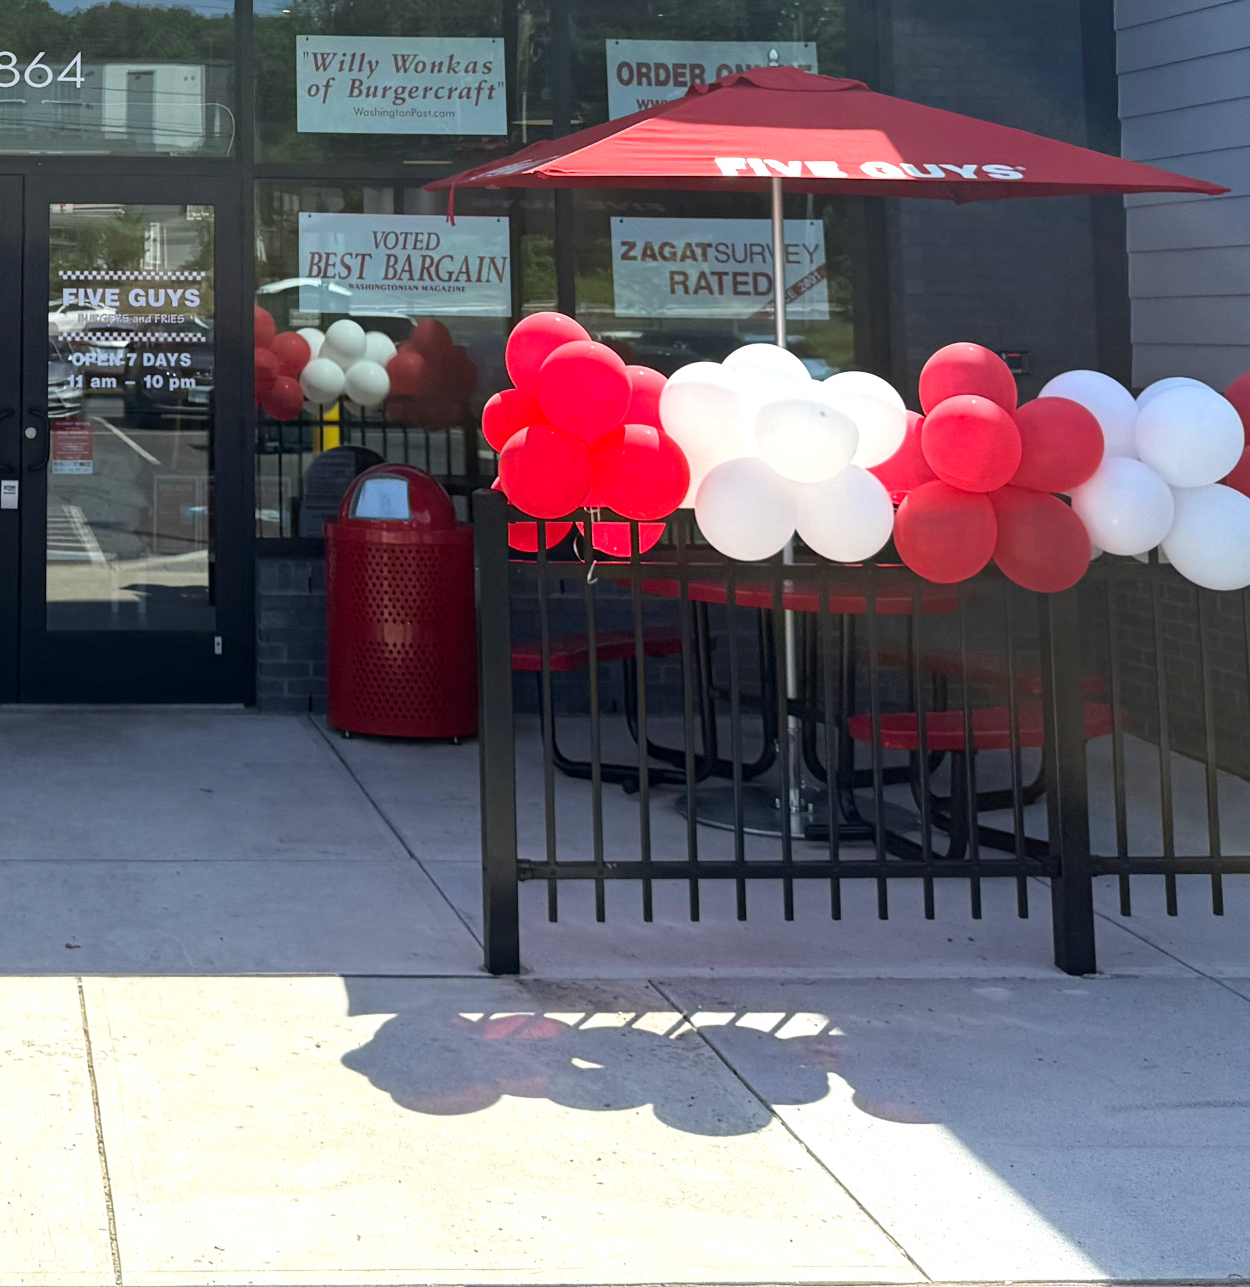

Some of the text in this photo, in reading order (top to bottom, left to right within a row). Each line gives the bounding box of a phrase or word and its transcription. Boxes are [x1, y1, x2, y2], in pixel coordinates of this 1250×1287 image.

[303, 51, 493, 79] "Willy Wonkas
[616, 60, 706, 87] ORDER
[307, 77, 504, 107] of Burgercraft"
[353, 107, 455, 119] WashingtonPost.com
[714, 157, 1024, 180] FIVE GUYS
[372, 230, 441, 251] VOTED
[307, 251, 508, 283] BEST BARGAIN
[348, 283, 466, 293] WASHINGTONIAN MAGAZINE
[669, 270, 773, 296] RATED
[797, 271, 822, 292] 2001
[62, 288, 201, 308] FIVE GUYS
[132, 314, 152, 324] and
[154, 314, 185, 324] FRIES
[71, 352, 192, 367] OPEN 7 DAYS
[67, 374, 84, 388] 11
[90, 377, 117, 388] am
[143, 374, 164, 388] 10
[168, 377, 196, 391] pm
